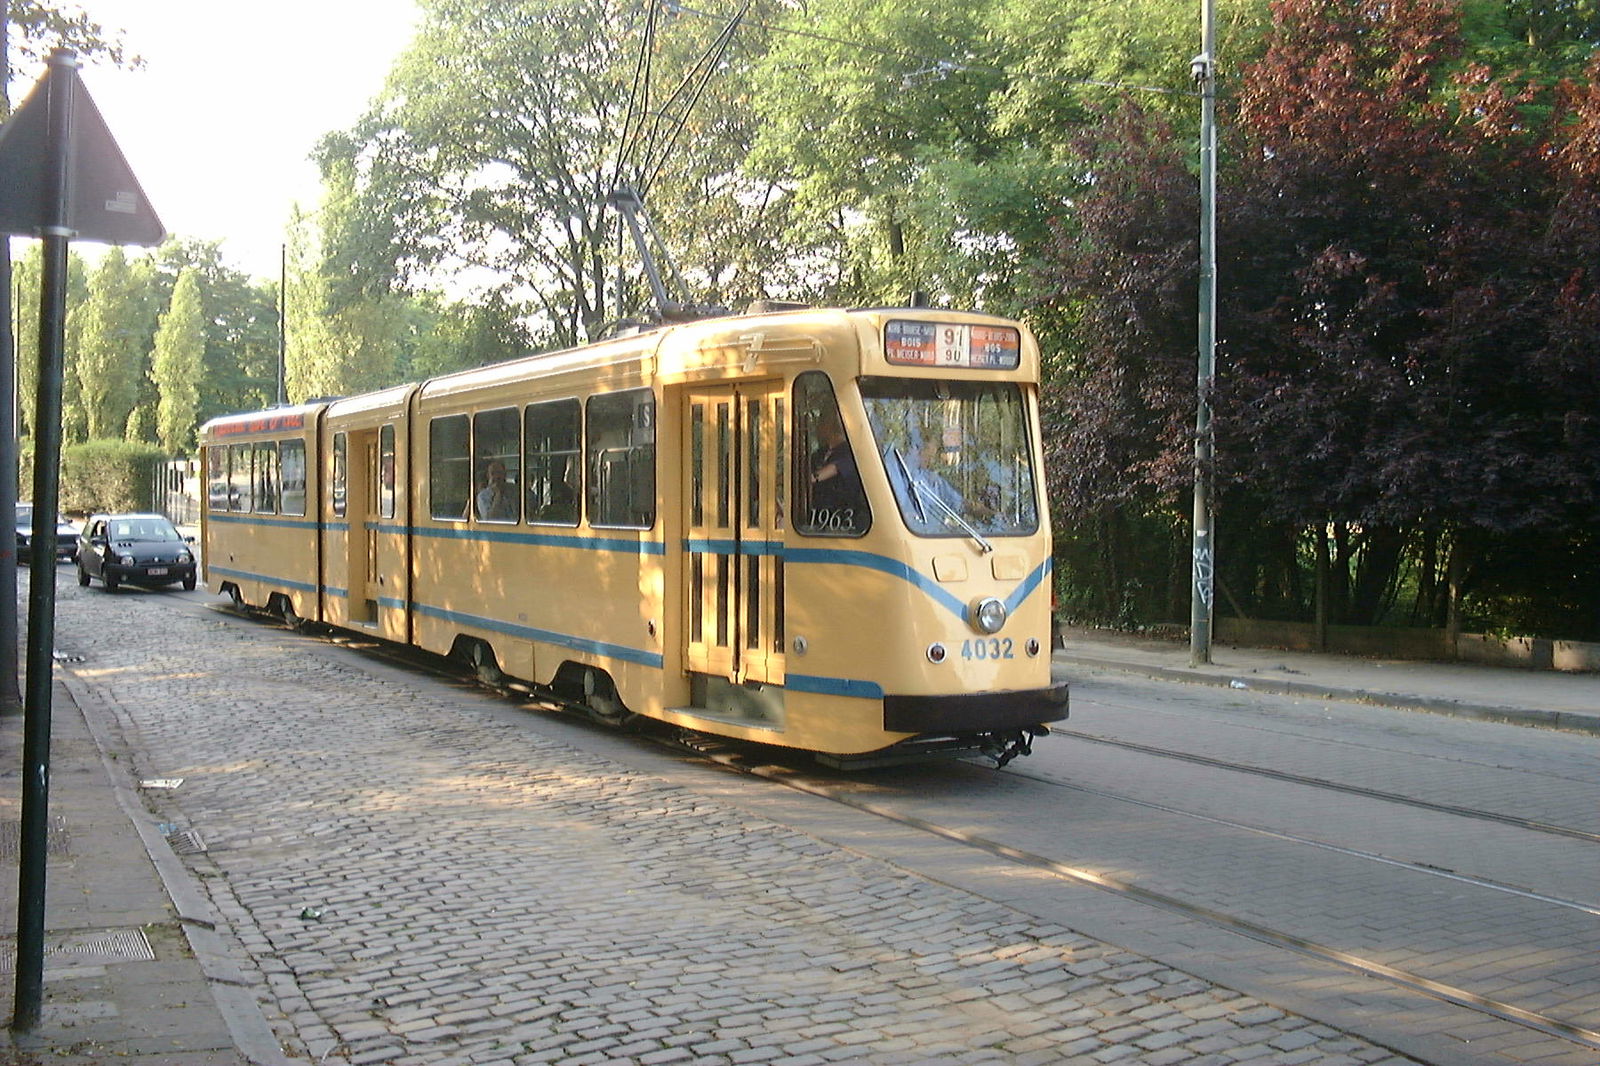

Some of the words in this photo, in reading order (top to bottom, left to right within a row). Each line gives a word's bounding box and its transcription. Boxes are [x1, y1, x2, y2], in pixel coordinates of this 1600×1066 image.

[901, 337, 921, 348] BOIS
[944, 328, 962, 346] 91
[945, 349, 961, 361] 90
[810, 508, 855, 531] 1963
[961, 637, 1014, 661] 4032
